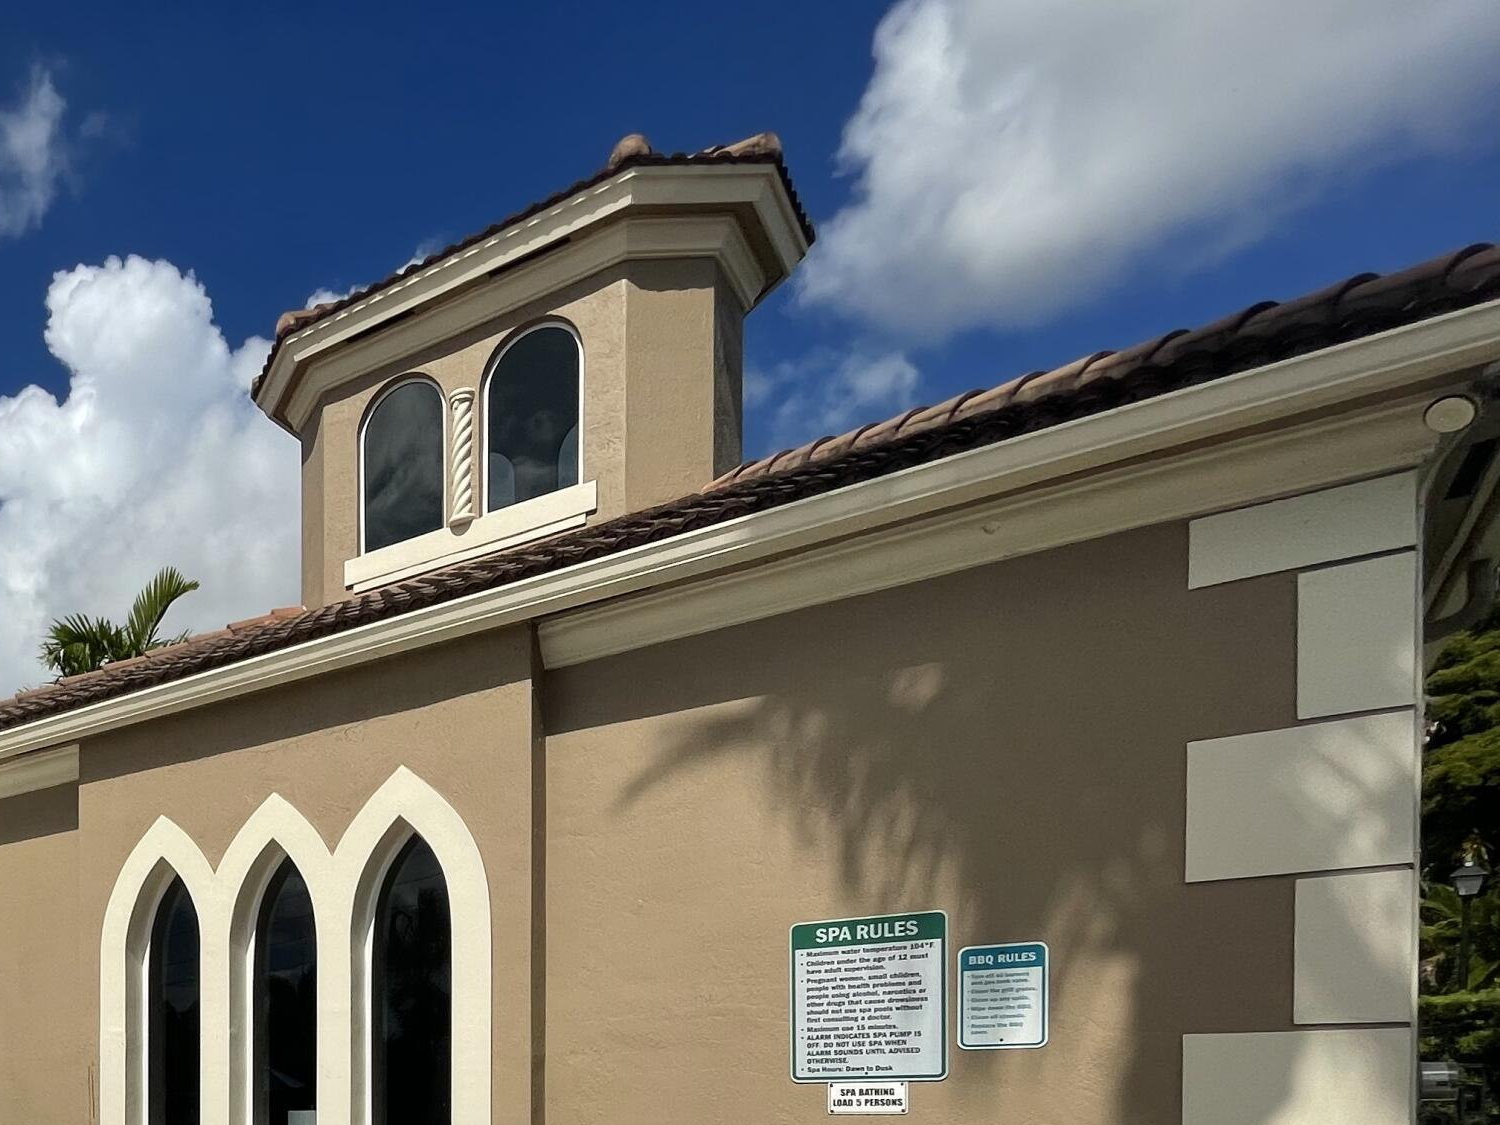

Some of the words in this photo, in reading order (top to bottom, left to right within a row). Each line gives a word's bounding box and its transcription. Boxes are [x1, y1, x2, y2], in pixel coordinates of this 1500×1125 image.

[815, 926, 852, 943] SPA
[856, 920, 919, 940] RULES
[898, 953, 908, 961] 12
[968, 954, 994, 965] BBQ
[998, 952, 1037, 963] RULES
[833, 1032, 871, 1040] INDICATES
[889, 1030, 913, 1038] PUMP
[835, 1040, 850, 1048] NOT
[865, 1047, 887, 1055] UNTIL
[888, 1046, 921, 1054] ADVISED
[840, 1088, 857, 1097] SPA
[858, 1087, 895, 1096] BATHING
[832, 1098, 854, 1107] LOAD
[856, 1098, 862, 1106] 5
[864, 1098, 903, 1107] PERSONS
